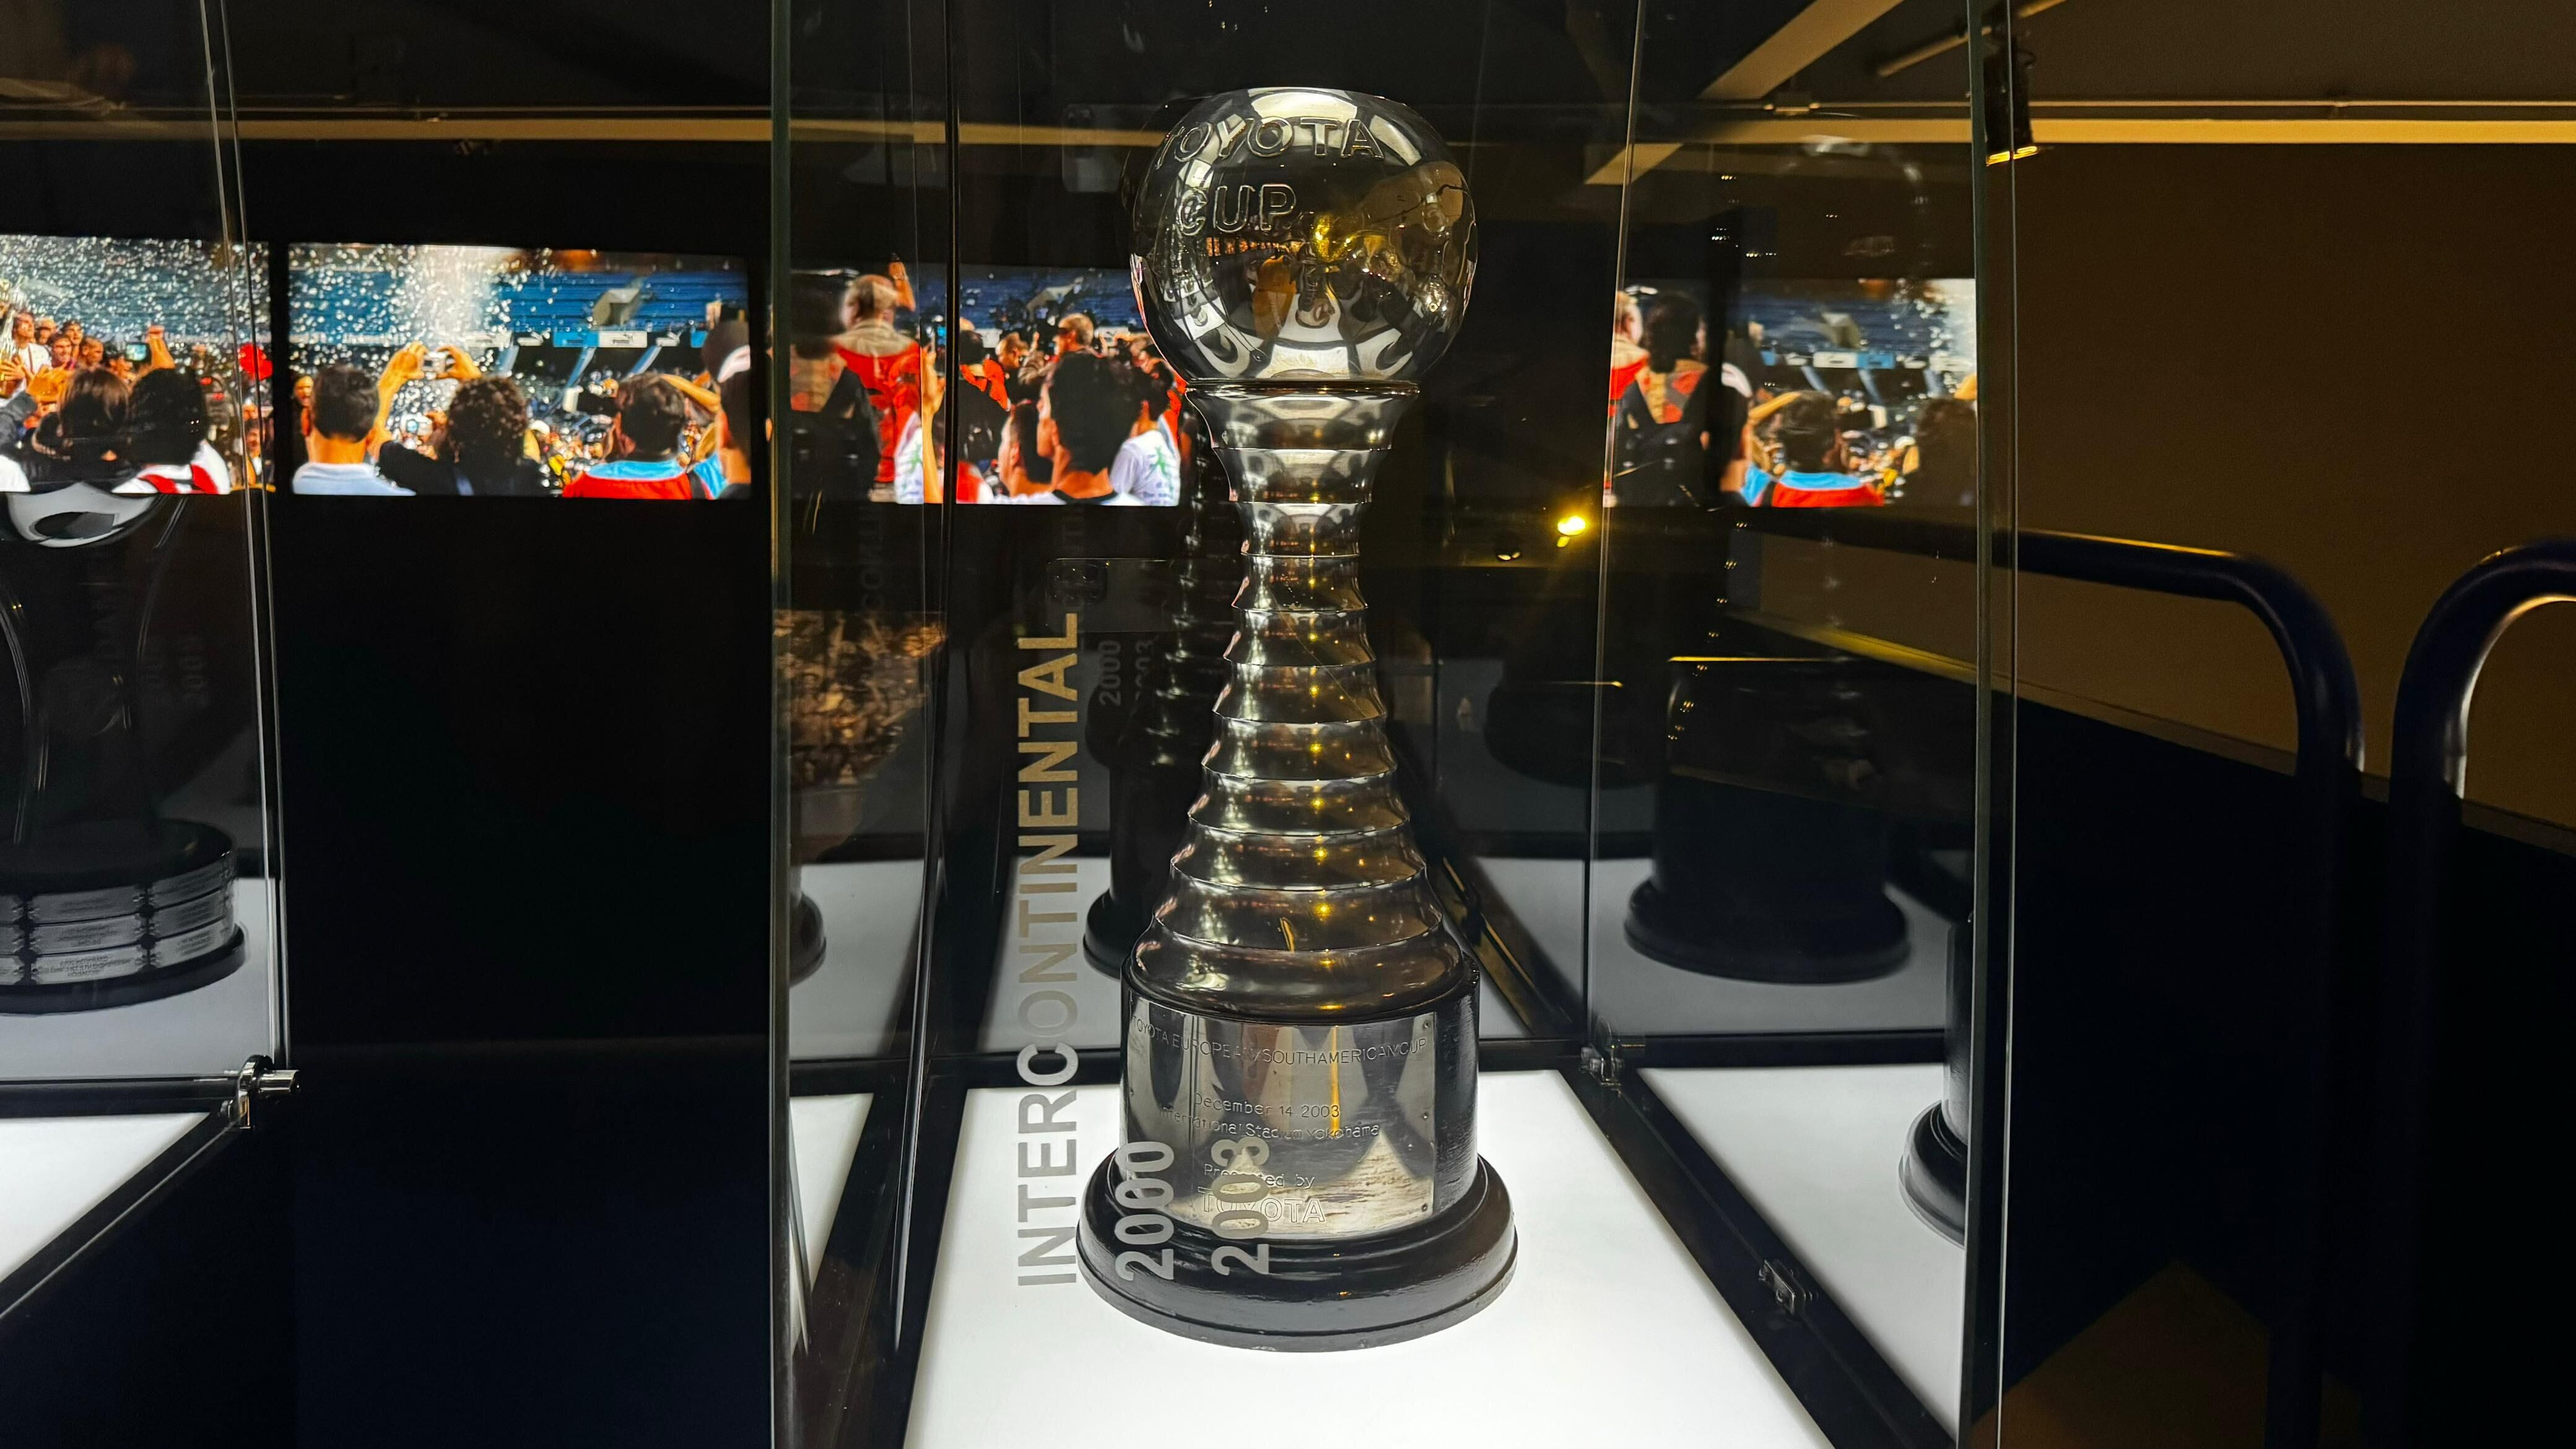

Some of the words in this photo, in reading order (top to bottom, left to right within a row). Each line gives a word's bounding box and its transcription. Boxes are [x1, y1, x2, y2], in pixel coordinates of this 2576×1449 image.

[1155, 116, 1385, 170] TOYOTA
[1178, 183, 1297, 236] CUP
[1098, 640, 1121, 707] 2000
[1017, 613, 1079, 1286] INTERCONTINENTAL
[1132, 1015, 1169, 1045] TOYOTA
[1194, 1092, 1273, 1115] December
[1279, 1105, 1294, 1116] 14
[1300, 1104, 1339, 1118] 2003
[1307, 1124, 1380, 1140] Yokohama
[1204, 1164, 1285, 1187] Prted
[1295, 1173, 1316, 1190] by
[1115, 1140, 1175, 1282] 2000
[1211, 1136, 1269, 1276] 2003
